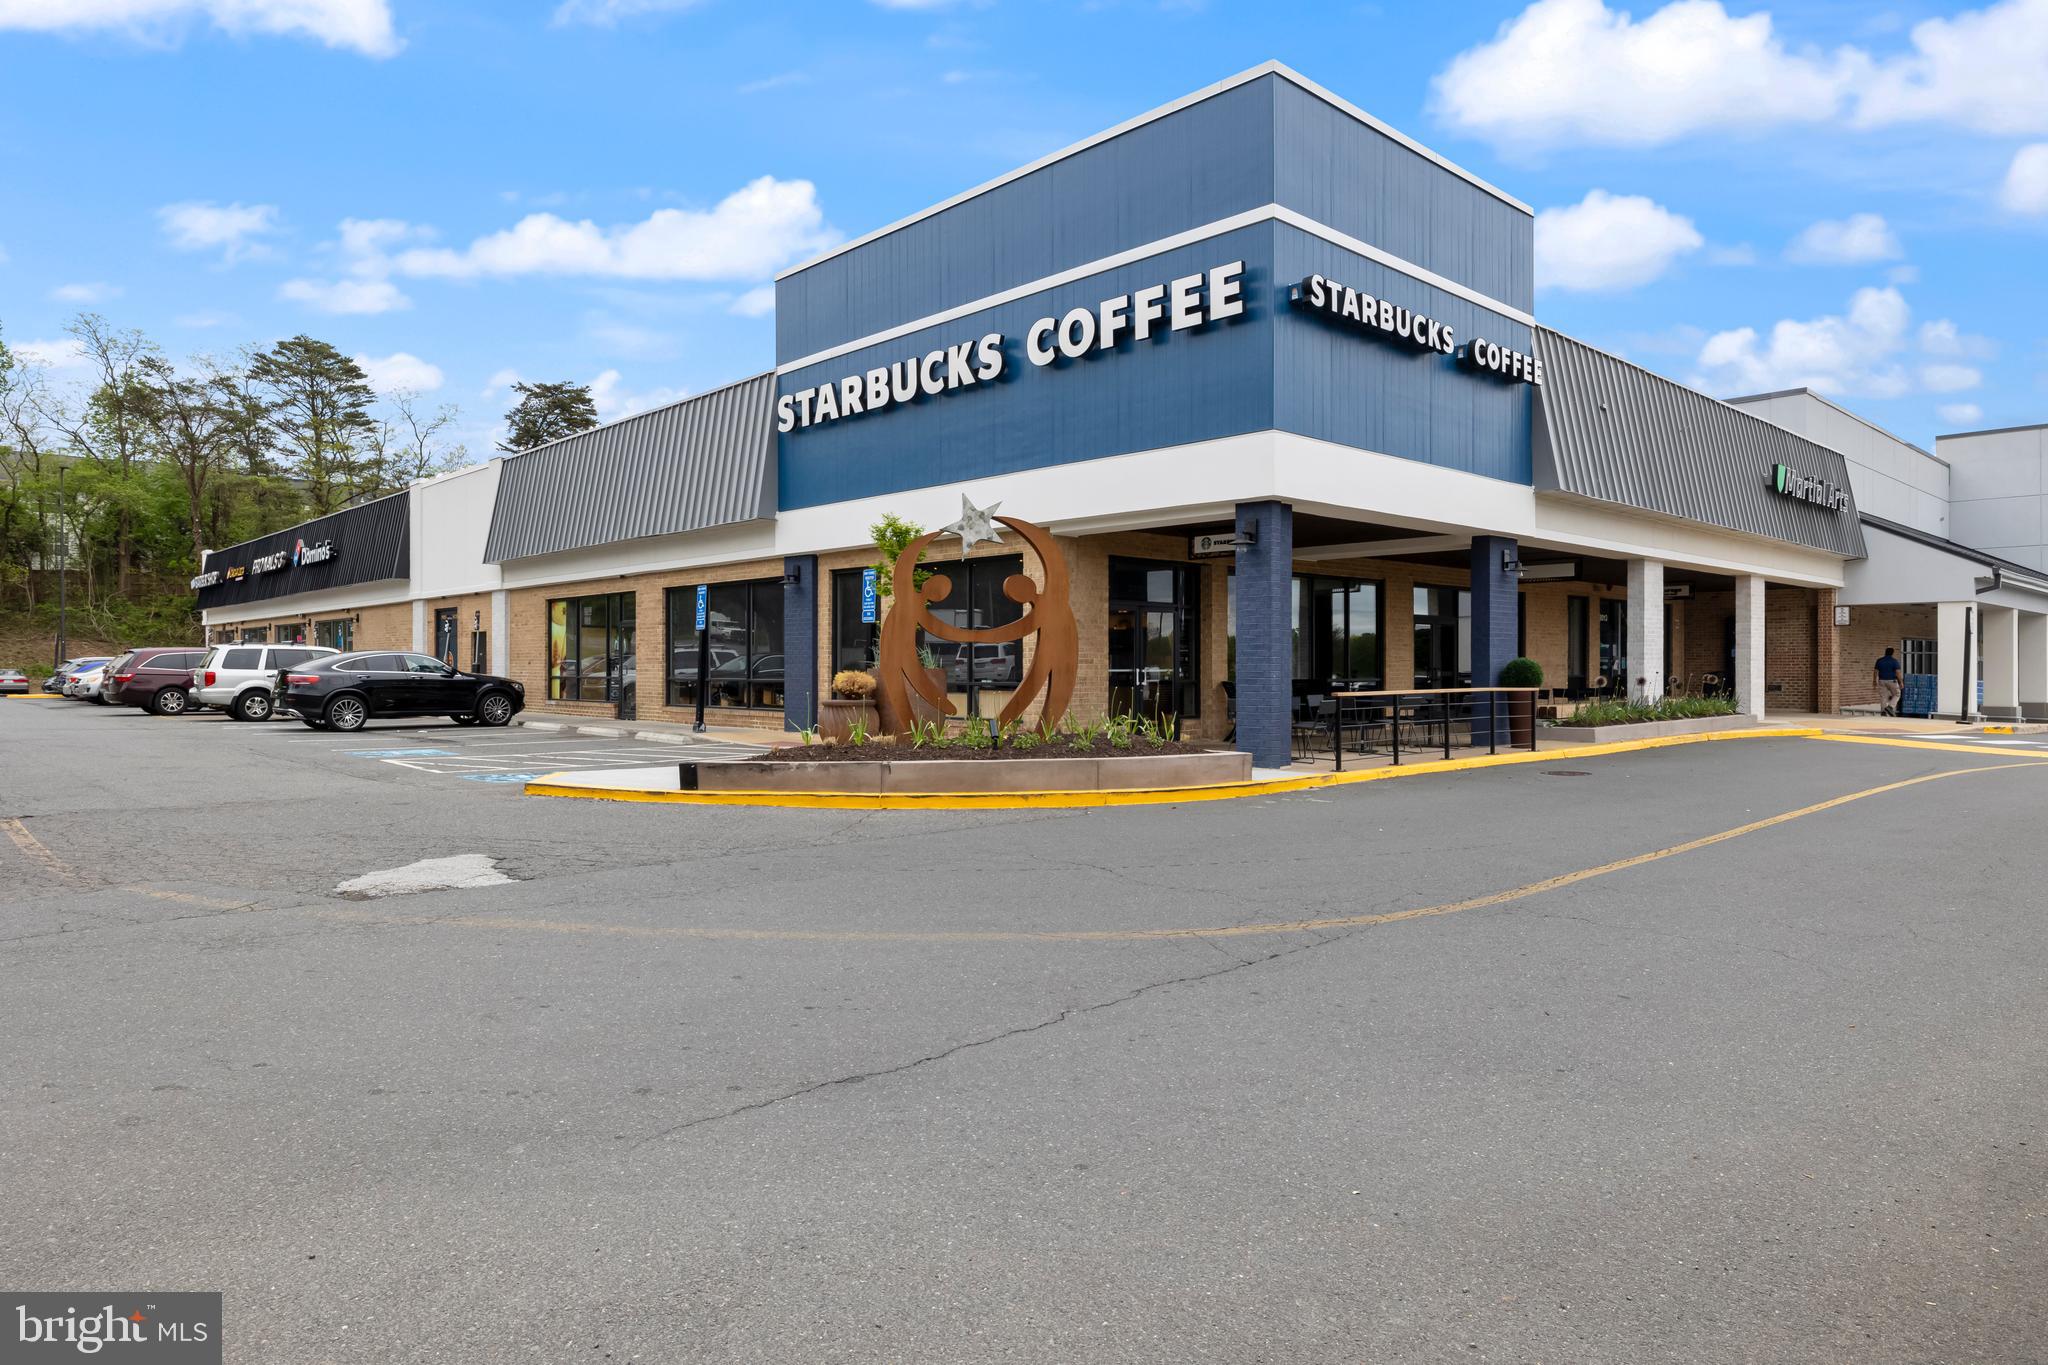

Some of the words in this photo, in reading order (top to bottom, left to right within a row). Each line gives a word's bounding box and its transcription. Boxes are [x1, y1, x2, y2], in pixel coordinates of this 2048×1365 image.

[778, 333, 1004, 433] STARBUCKS
[1027, 260, 1245, 367] COFFEE
[1311, 274, 1455, 354] STARBUCKS
[1474, 337, 1543, 386] COFFEE
[1785, 466, 1826, 506] Martial
[1827, 482, 1849, 513] Arts
[301, 545, 330, 566] Domino's
